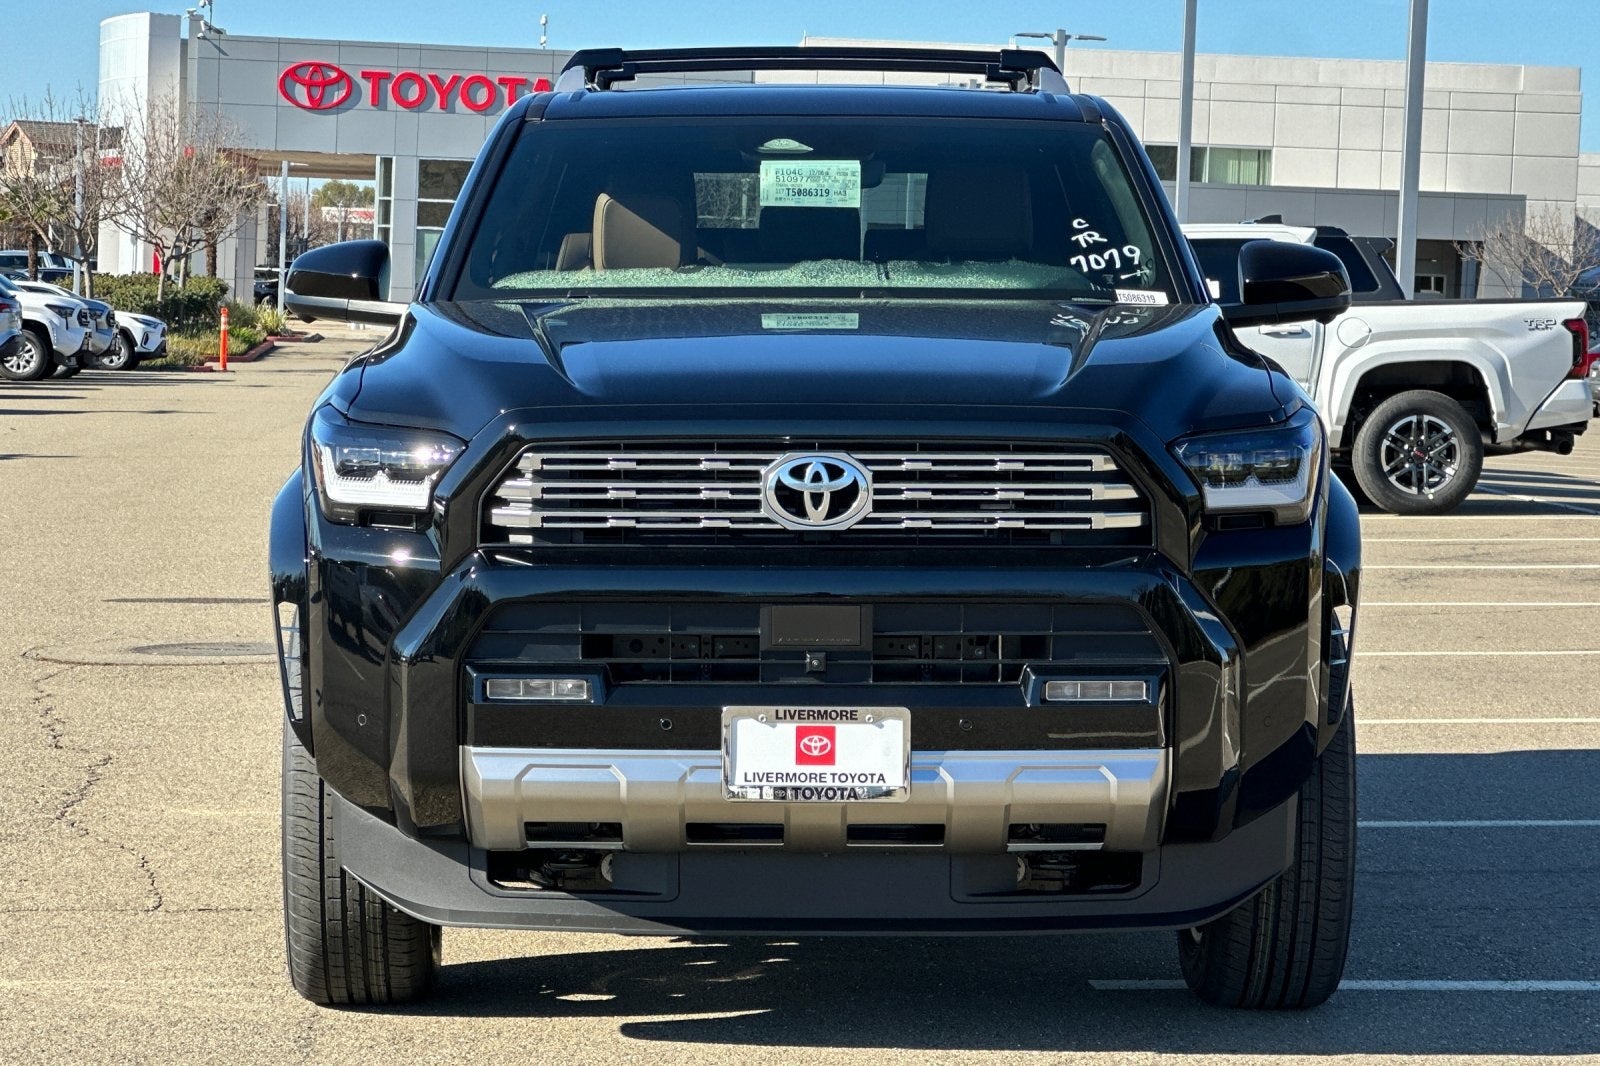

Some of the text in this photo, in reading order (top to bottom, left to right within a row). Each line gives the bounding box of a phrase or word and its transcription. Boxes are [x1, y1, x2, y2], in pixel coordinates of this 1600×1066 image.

[786, 187, 830, 197] T5086319
[1070, 244, 1141, 273] 7079
[1118, 293, 1156, 303] T5086319
[775, 709, 859, 721] LIVERMORE
[744, 772, 886, 784] LIVERMORE TOYOTA
[792, 786, 859, 800] TOYOTA
